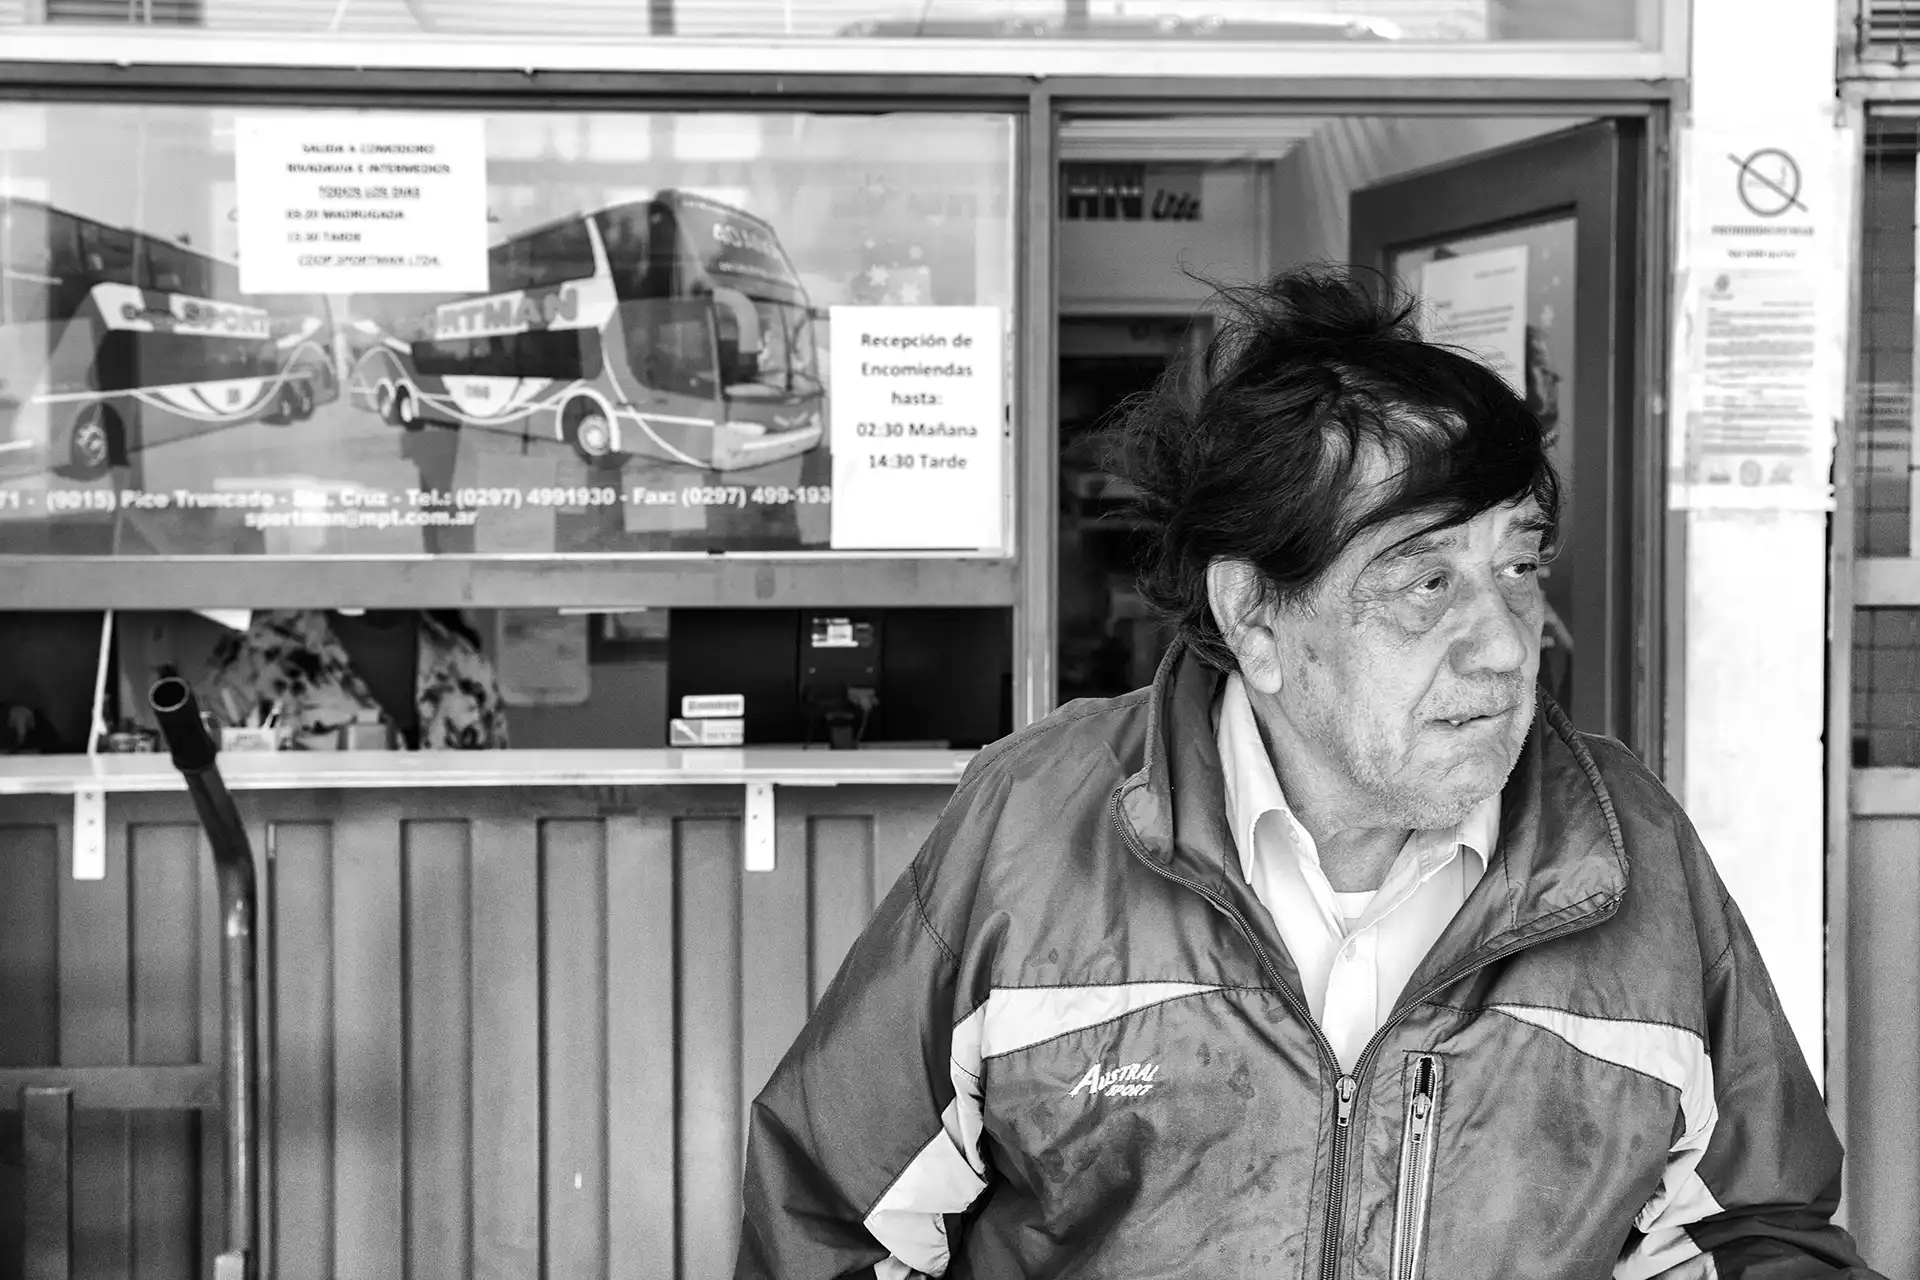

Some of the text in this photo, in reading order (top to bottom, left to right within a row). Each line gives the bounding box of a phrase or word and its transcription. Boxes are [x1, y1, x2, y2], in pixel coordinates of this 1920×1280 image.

[861, 332, 973, 350] Recepción de
[861, 361, 973, 378] Encomiendas
[891, 391, 943, 406] hasta:
[856, 421, 978, 438] 02:30 Mañana
[869, 453, 968, 470] 14:30 Tarde
[340, 486, 388, 506] Cruz
[455, 488, 522, 510] (0297)
[526, 486, 615, 506] 4991930
[681, 486, 747, 508] (0297)
[751, 485, 831, 504] 499-193
